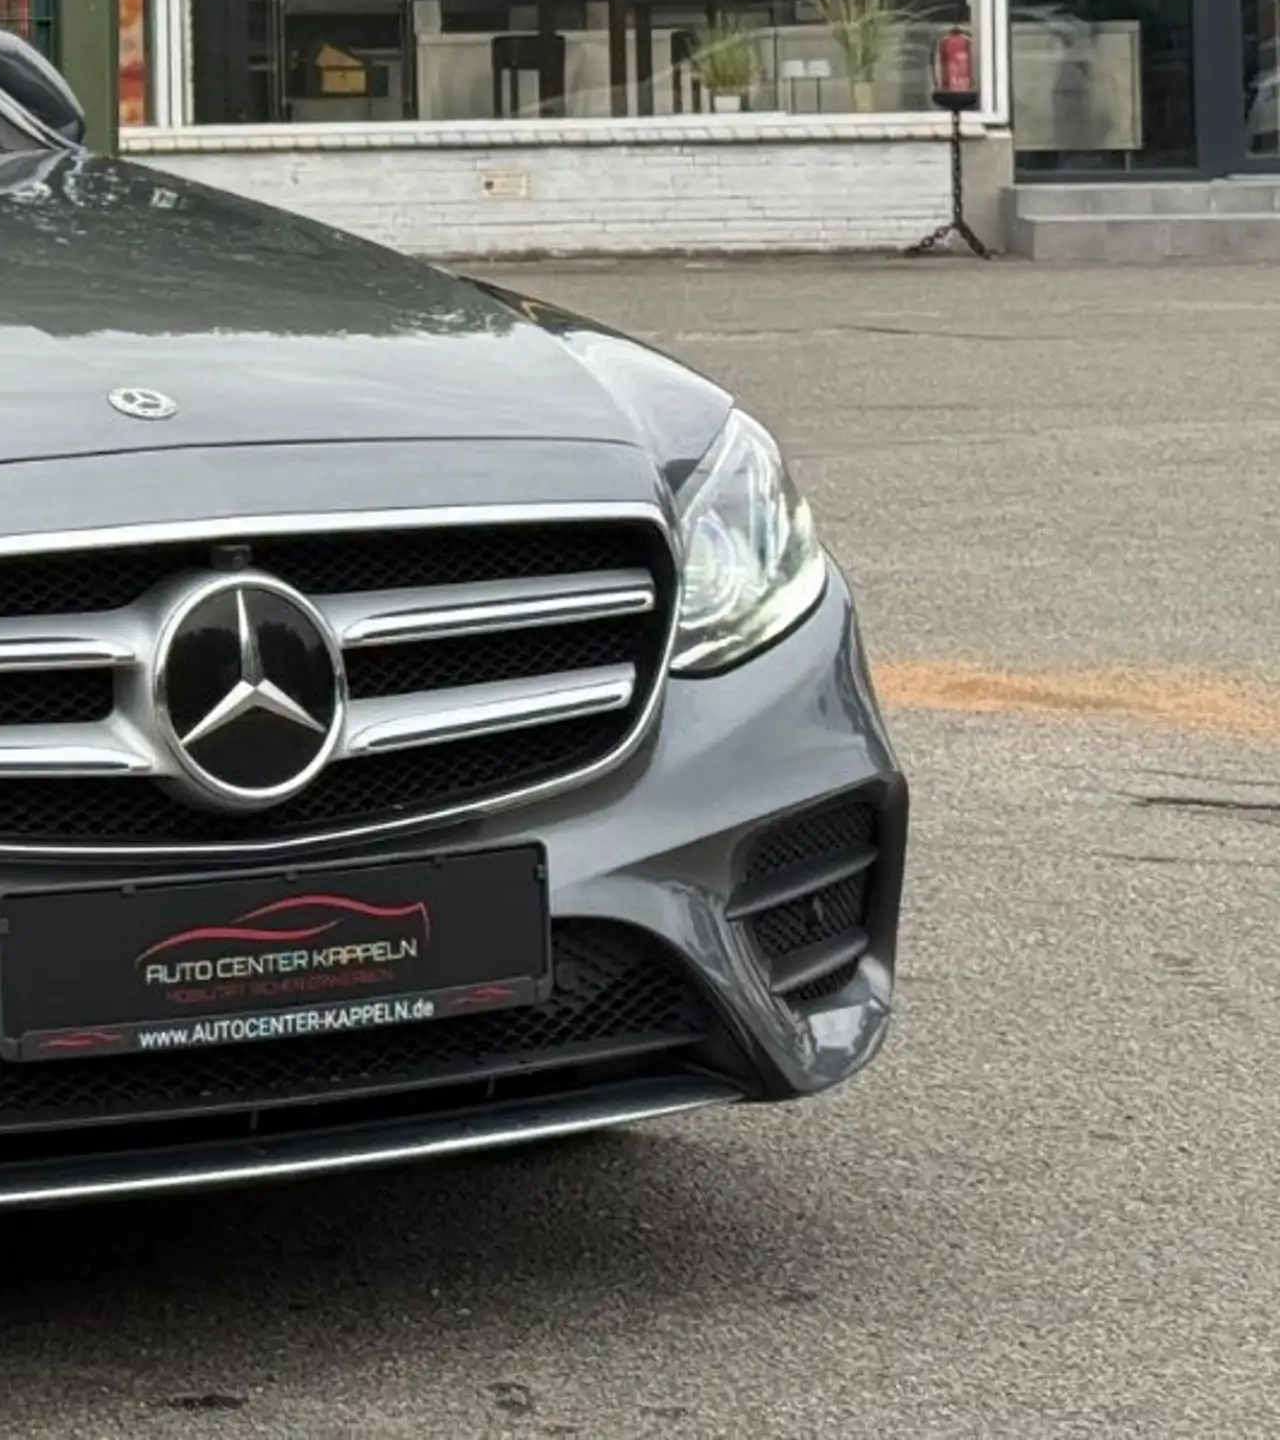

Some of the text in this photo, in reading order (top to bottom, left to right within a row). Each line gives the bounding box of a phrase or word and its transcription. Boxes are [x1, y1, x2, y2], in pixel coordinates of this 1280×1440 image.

[146, 939, 417, 983] AUTO CENTER KAPPELN
[138, 997, 434, 1048] www.AUTOCENTER-KAPPELN.de
